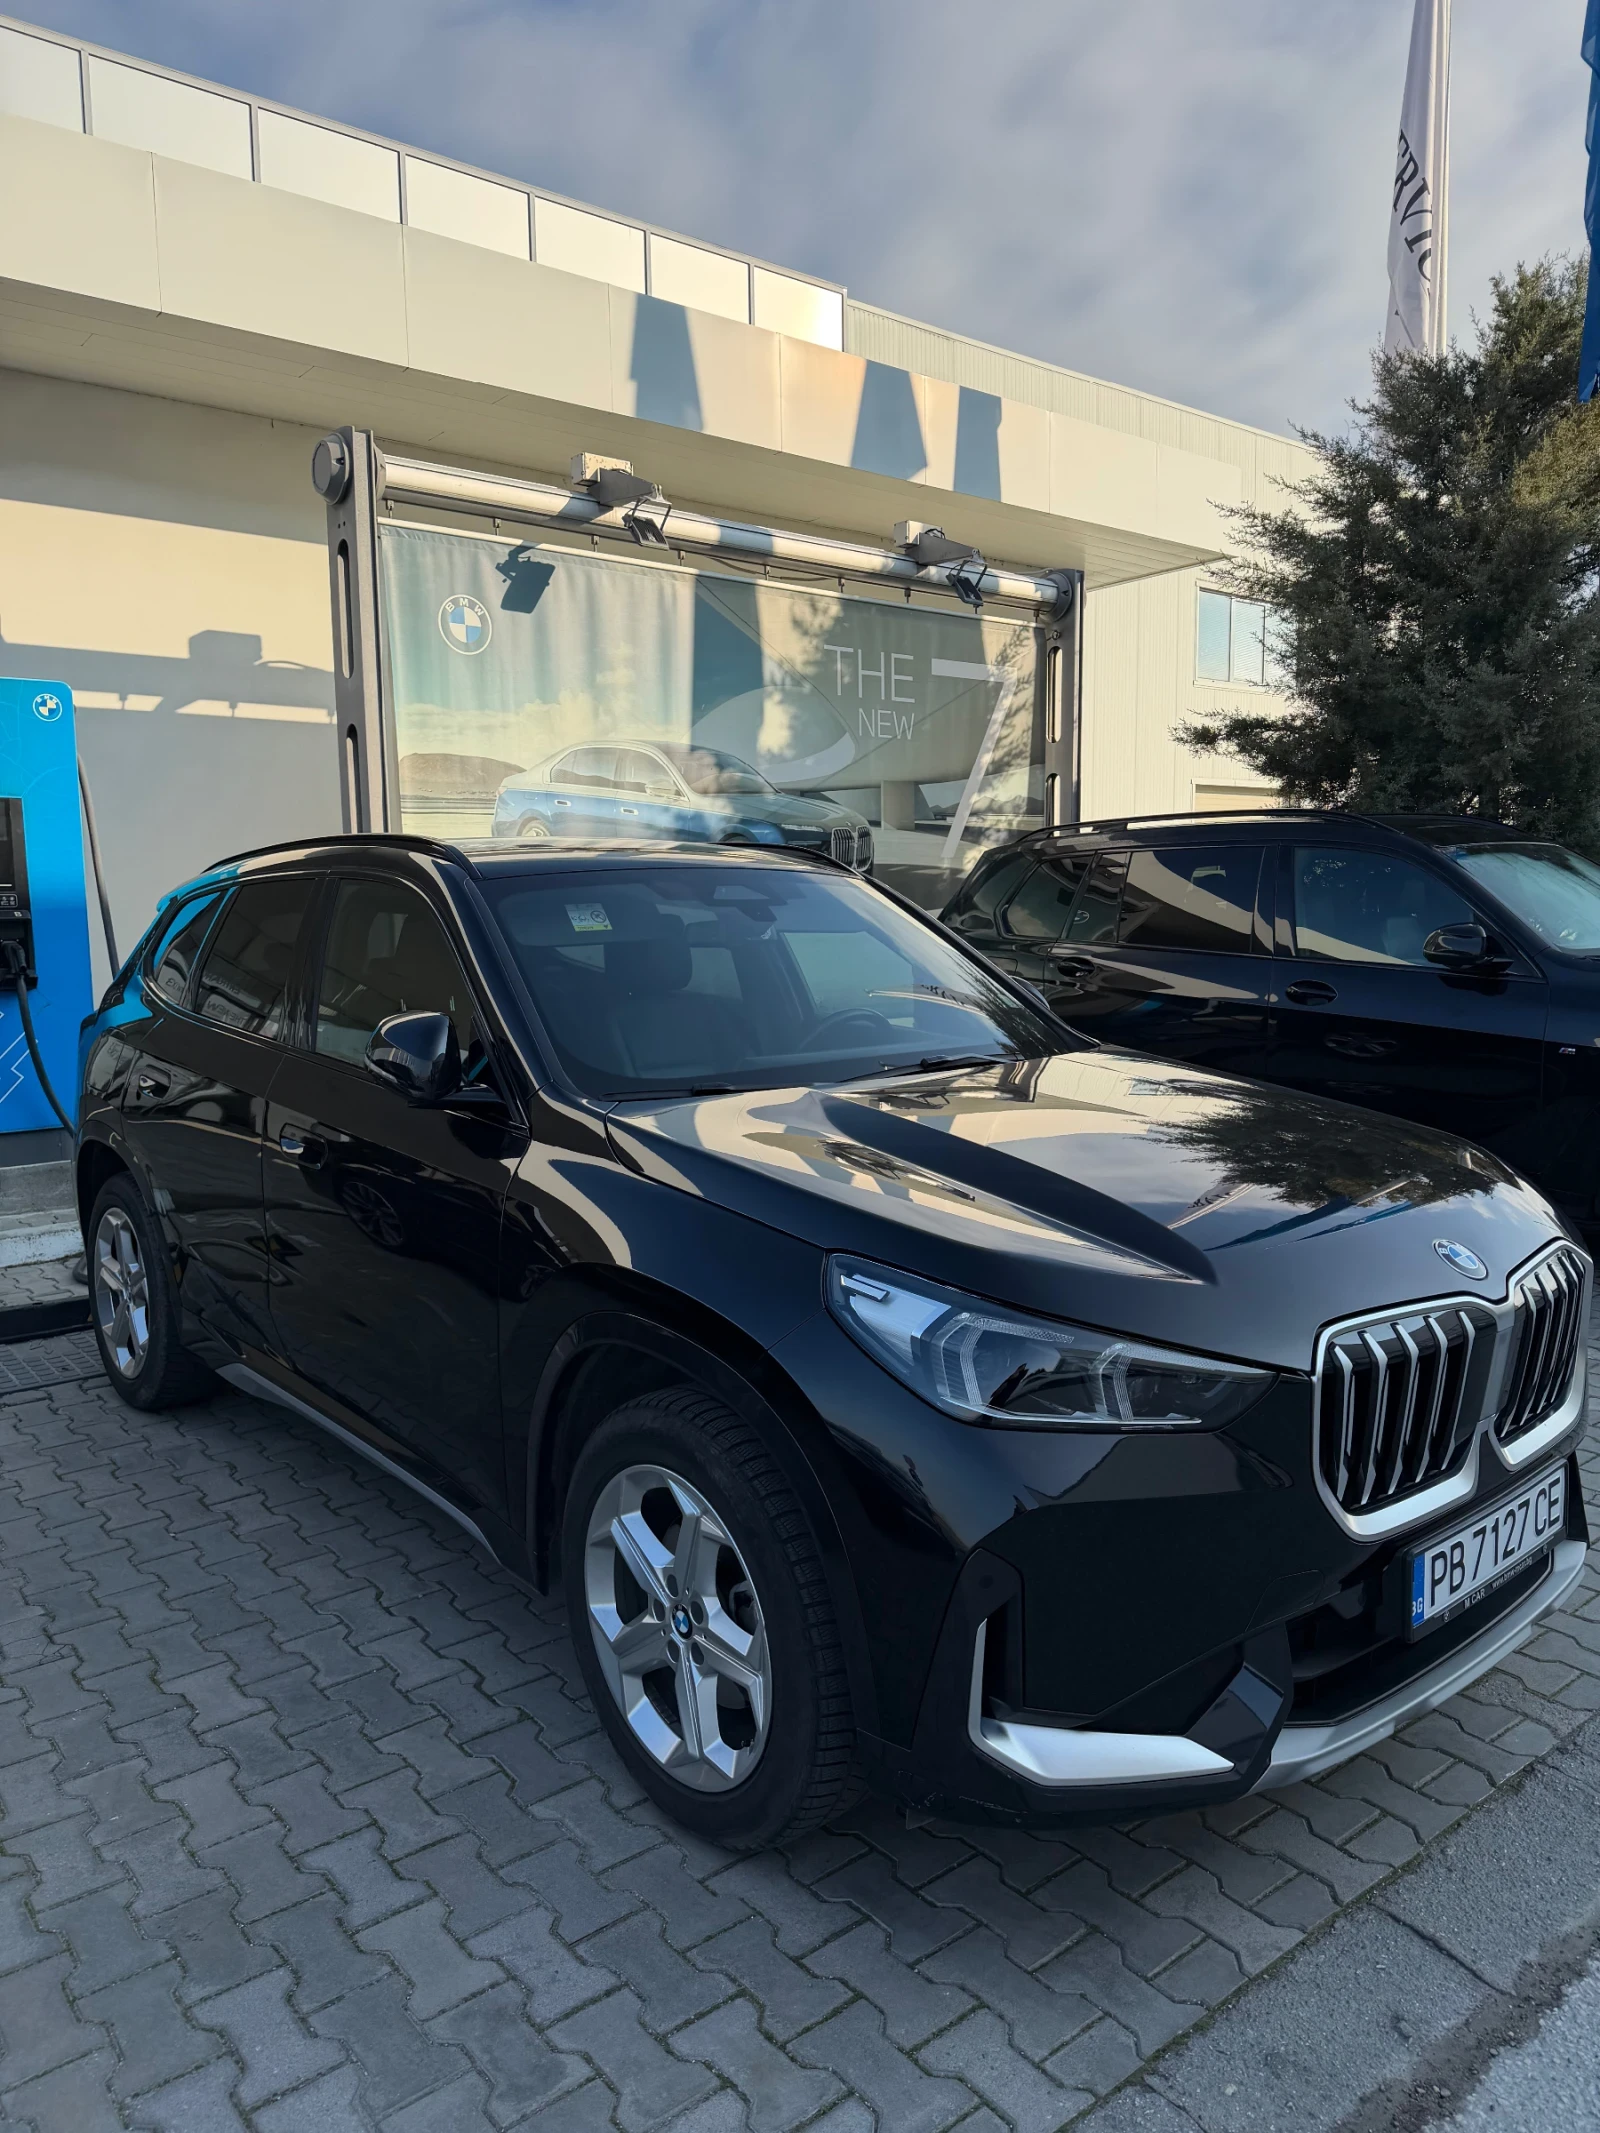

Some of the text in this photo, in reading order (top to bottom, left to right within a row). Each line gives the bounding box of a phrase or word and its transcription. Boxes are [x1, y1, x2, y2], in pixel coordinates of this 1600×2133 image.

[445, 597, 484, 616] BMW
[823, 644, 916, 704] THE
[858, 707, 915, 740] NEW
[931, 658, 1018, 858] 7
[1471, 1588, 1486, 1604] CAR
